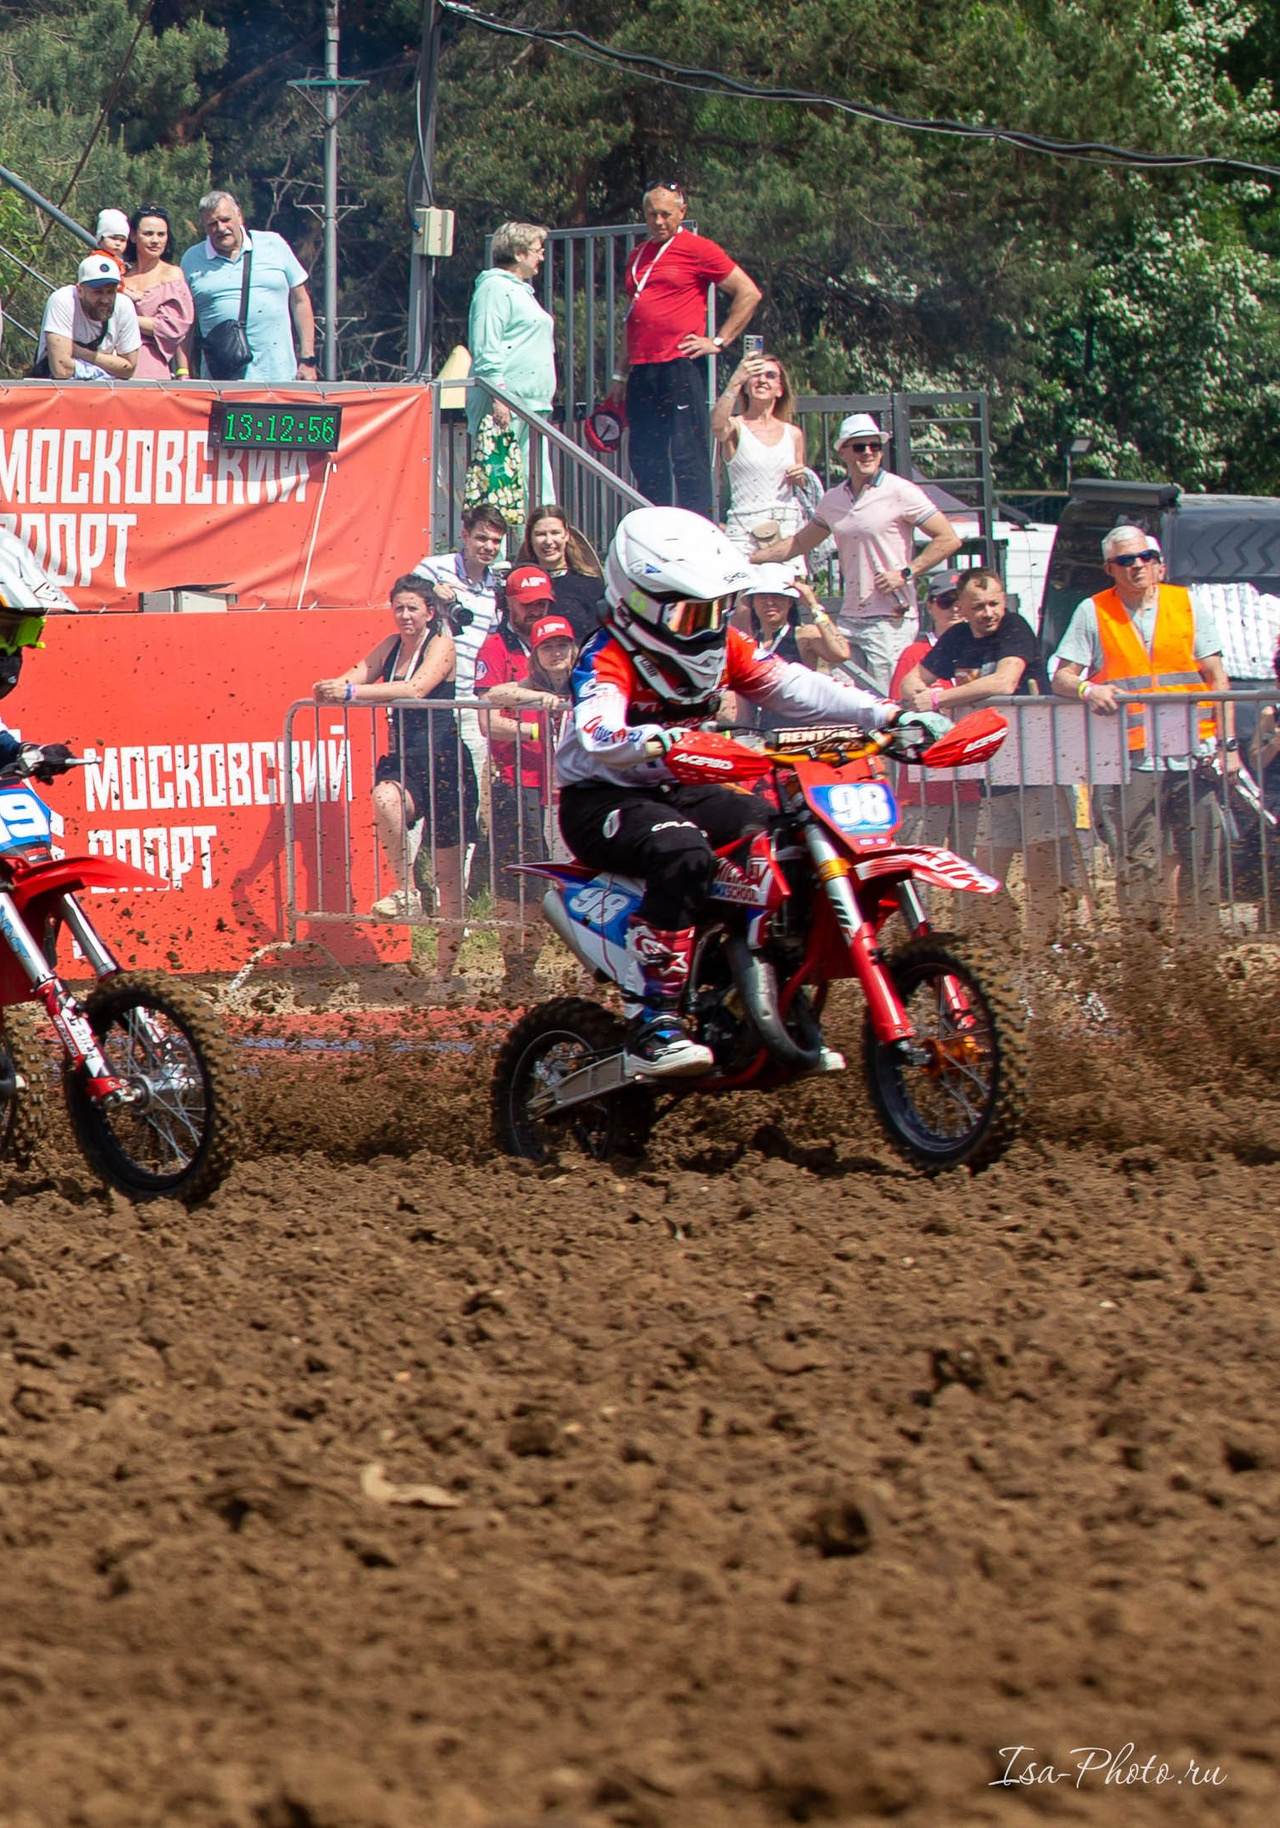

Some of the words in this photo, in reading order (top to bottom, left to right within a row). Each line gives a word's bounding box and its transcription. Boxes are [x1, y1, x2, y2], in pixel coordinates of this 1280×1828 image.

[224, 412, 336, 444] 13:12:56
[83, 725, 353, 812] МОСКОВСКИЙ
[827, 784, 891, 826] 98
[569, 886, 631, 926] 98
